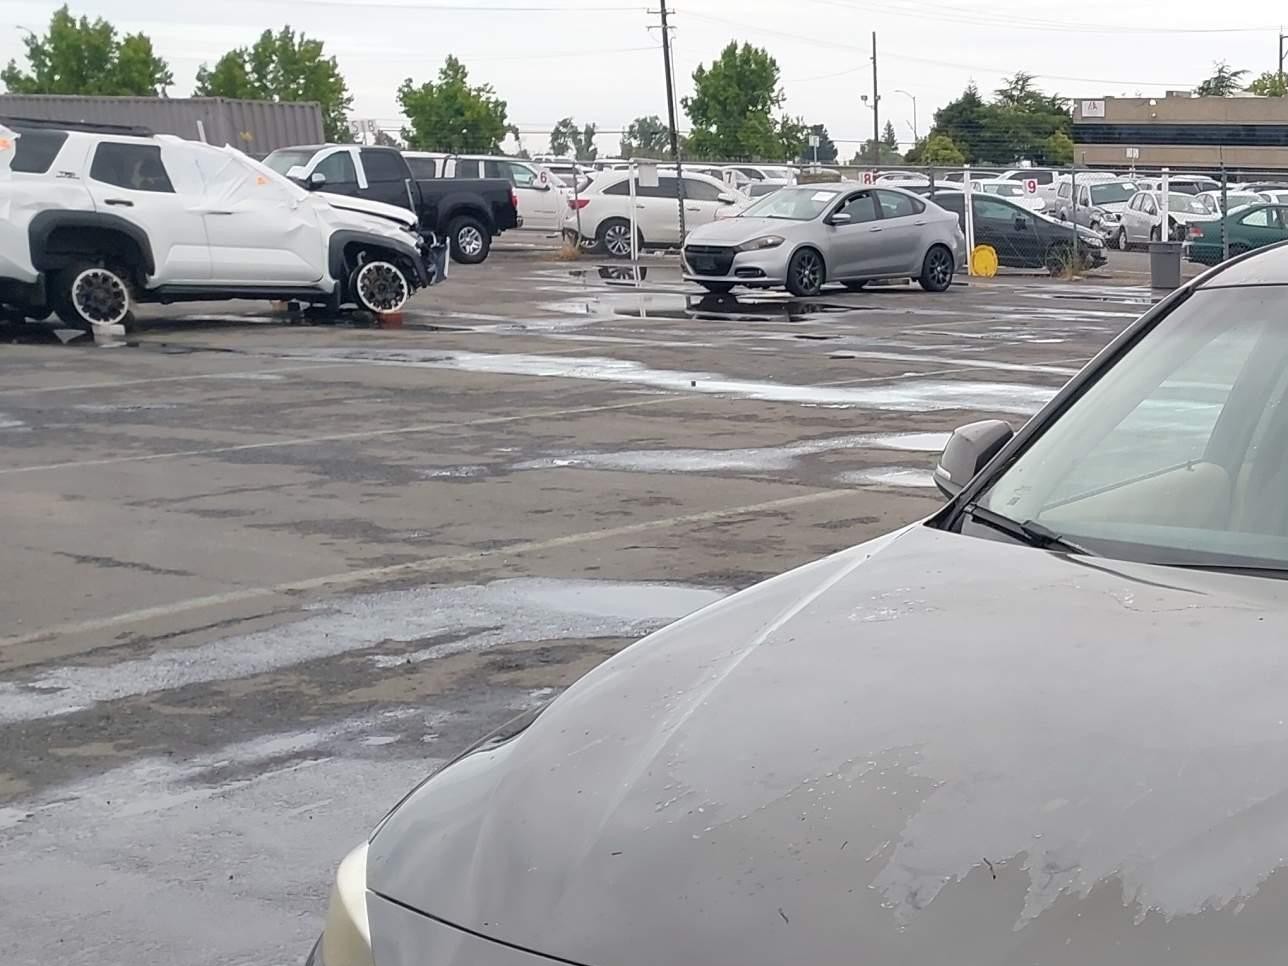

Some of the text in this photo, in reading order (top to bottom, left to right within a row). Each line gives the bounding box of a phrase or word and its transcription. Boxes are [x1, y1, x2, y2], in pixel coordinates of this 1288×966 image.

[540, 171, 547, 184] 6
[725, 171, 733, 184] 7
[1028, 180, 1036, 194] 9
